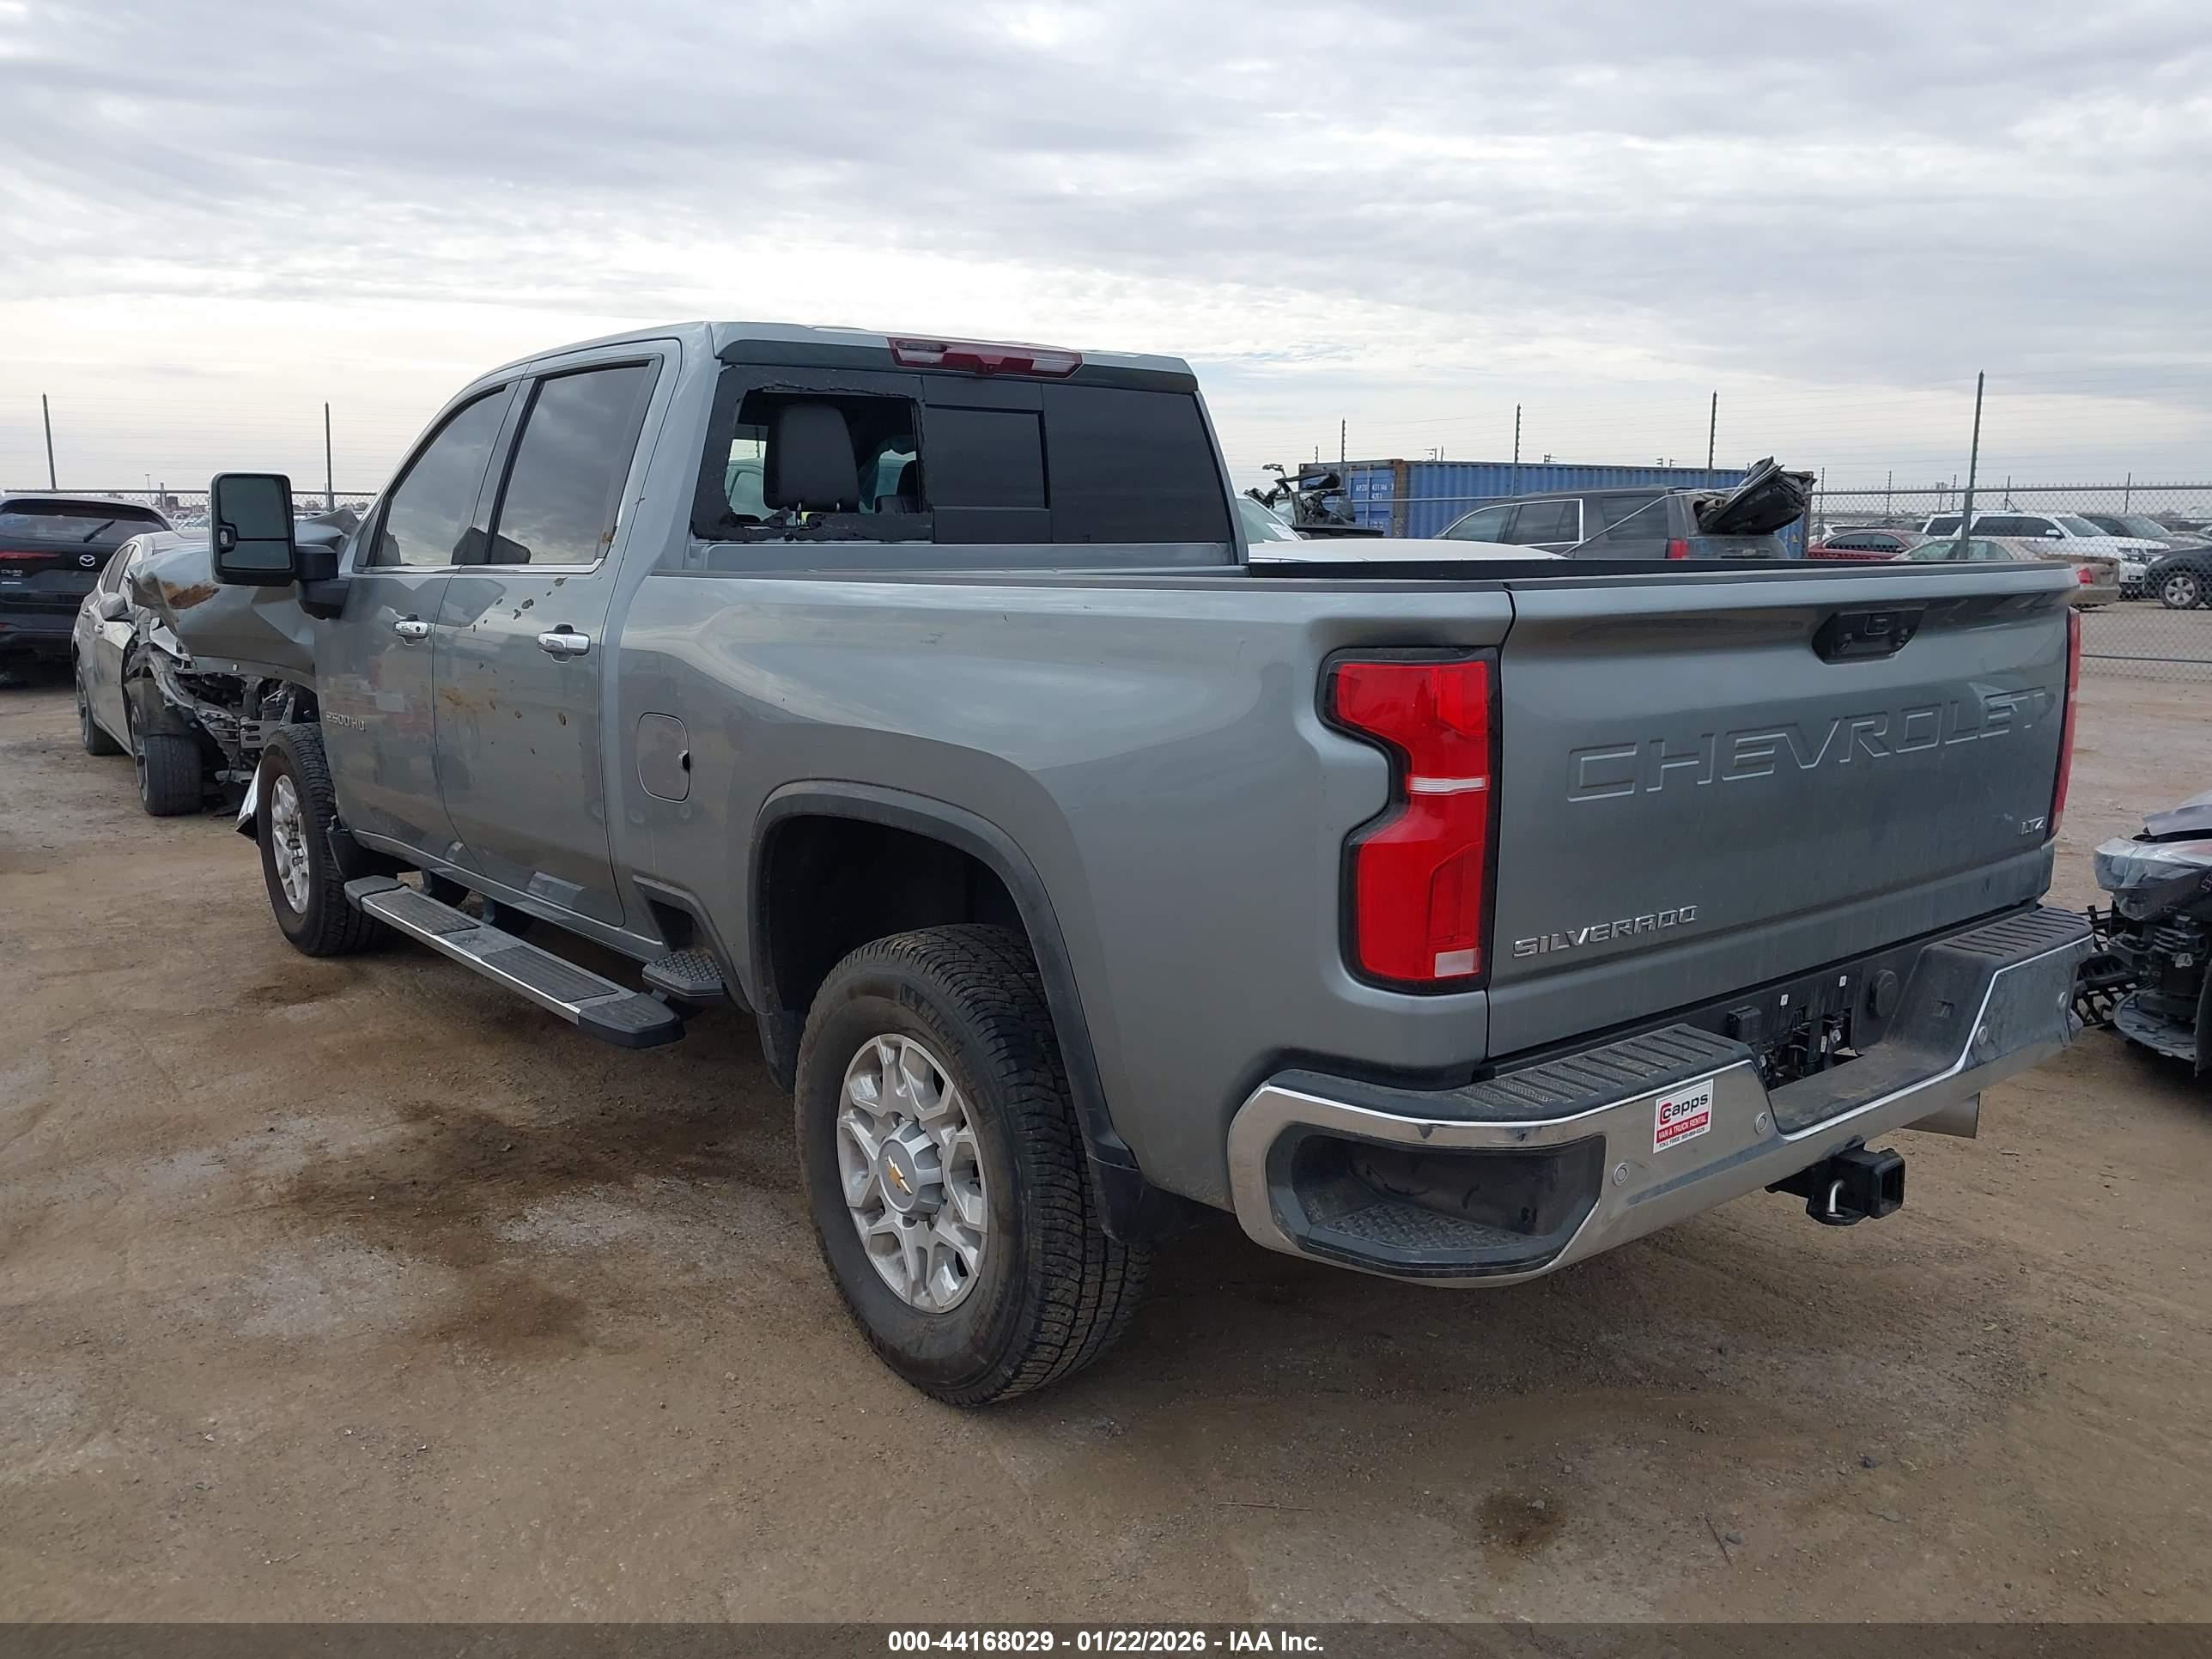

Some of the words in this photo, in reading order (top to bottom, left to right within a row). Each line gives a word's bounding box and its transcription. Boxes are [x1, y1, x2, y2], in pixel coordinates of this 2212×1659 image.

[326, 711, 349, 726] 2500
[1566, 687, 2051, 803] CHEVROLET
[2020, 816, 2045, 835] LTZ
[1513, 905, 1698, 958] SILVERADO
